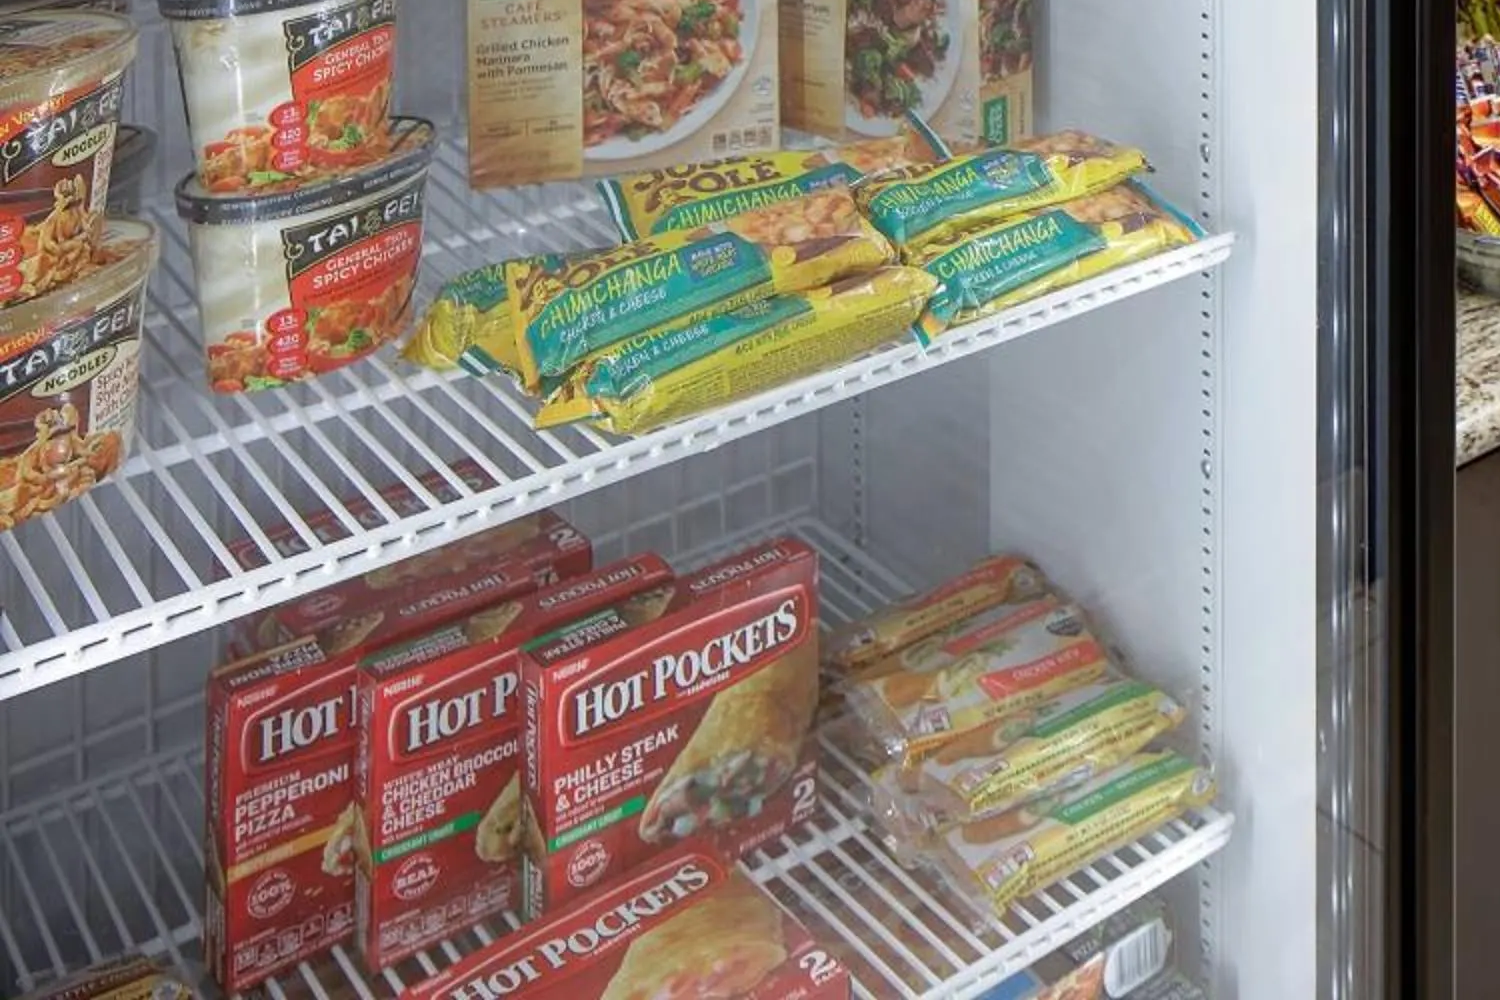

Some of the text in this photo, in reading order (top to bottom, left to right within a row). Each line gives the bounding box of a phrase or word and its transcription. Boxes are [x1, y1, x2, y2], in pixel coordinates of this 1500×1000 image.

[520, 35, 570, 51] Chicken
[313, 58, 353, 82] SPICY
[307, 192, 419, 254] TAI PEI
[666, 183, 804, 232] CHIMICHANGA
[311, 263, 360, 290] SPICY
[325, 243, 382, 272] GENERAL
[539, 252, 682, 340] CHIMICHANGA
[618, 287, 667, 317] CHEESE
[93, 305, 133, 342] PEI
[43, 351, 109, 392] NOODLES
[575, 669, 649, 737] HOT
[652, 597, 798, 701] POCKETS
[259, 696, 344, 762] HOT
[407, 687, 487, 752] HOT
[381, 738, 520, 806] CHICKEN BROCCOL
[553, 723, 680, 796] PHILLY STEAK
[235, 769, 302, 805] PREMIUM
[235, 763, 350, 825] PEPPERONI
[381, 772, 477, 822] & CHEDDAR
[555, 793, 571, 813] &
[573, 757, 645, 804] CHEESE
[793, 776, 816, 813] 2
[235, 804, 296, 843] PIZZA
[381, 800, 446, 836] CHEESE
[450, 953, 546, 1000] HOT
[537, 863, 711, 970] POCKETS
[801, 950, 836, 978] 2
